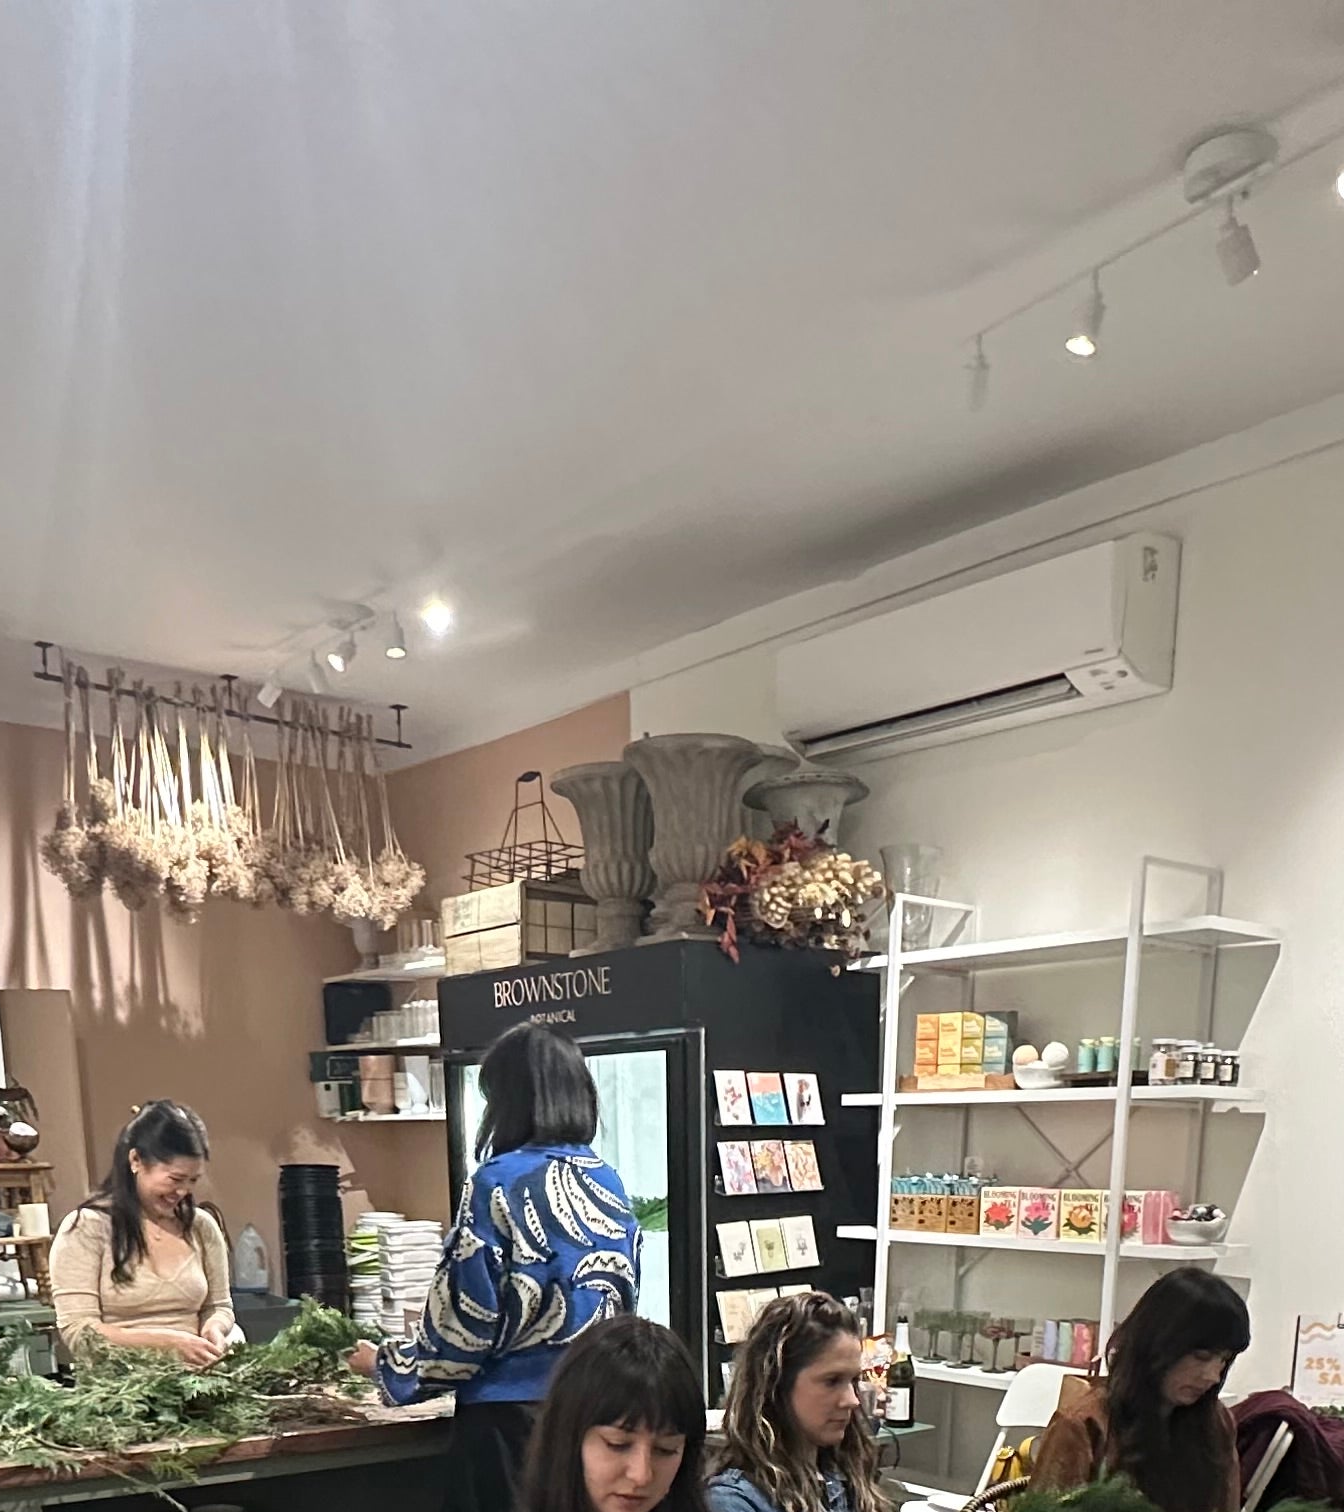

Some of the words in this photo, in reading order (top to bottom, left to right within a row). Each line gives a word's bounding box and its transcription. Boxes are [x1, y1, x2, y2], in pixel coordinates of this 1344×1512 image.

[493, 966, 612, 1008] BROWNSTONE
[529, 1009, 577, 1025] BOTANICAL
[1021, 1193, 1056, 1202] BLOOMING
[1042, 1202, 1055, 1211] TEA
[1305, 1357, 1340, 1370] 25%
